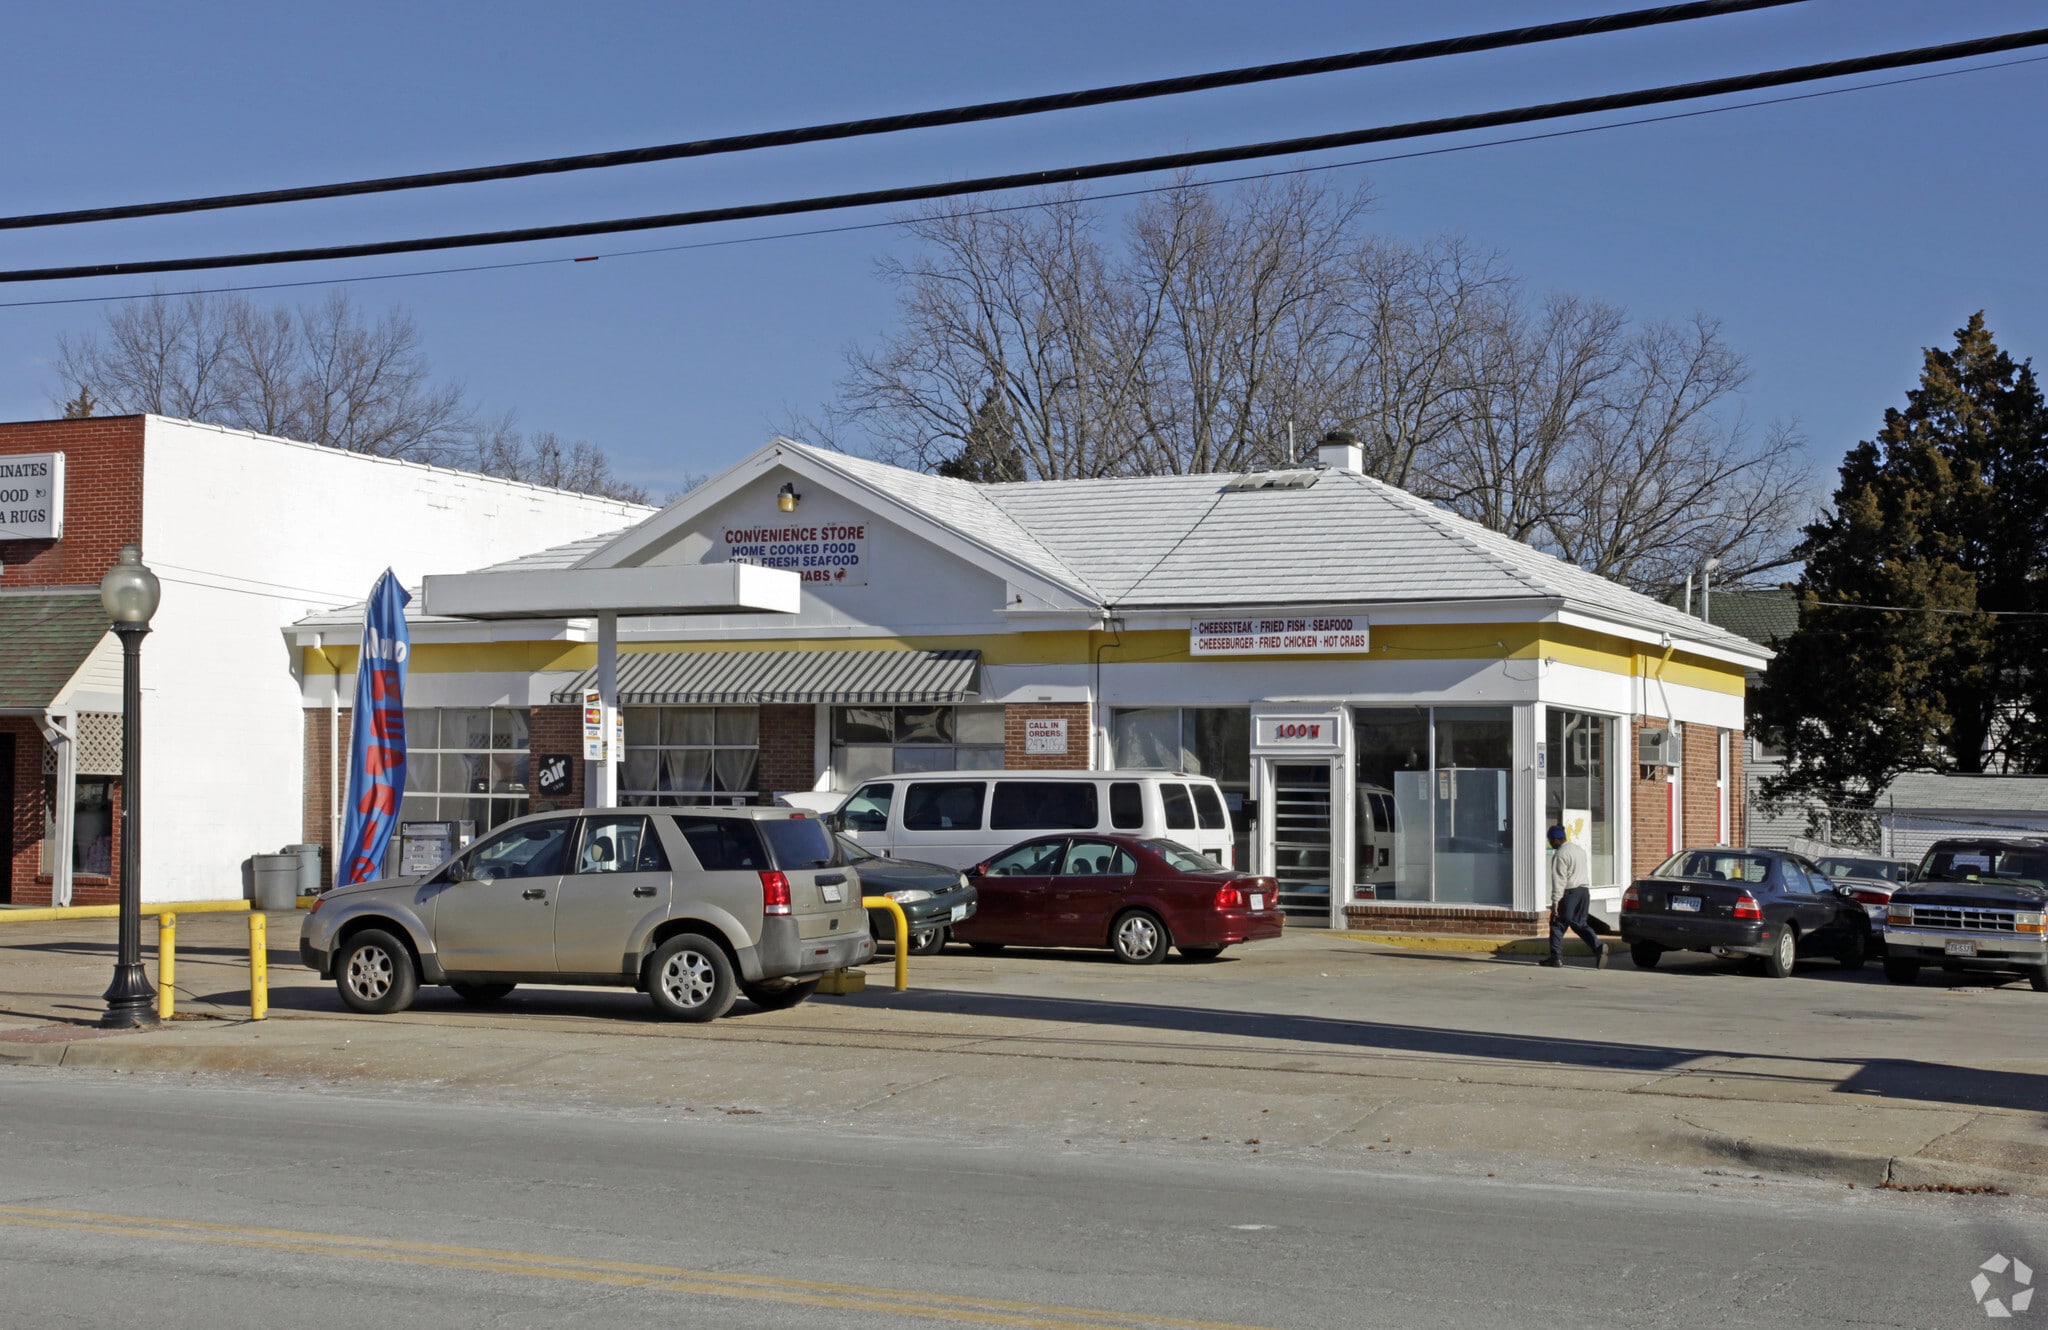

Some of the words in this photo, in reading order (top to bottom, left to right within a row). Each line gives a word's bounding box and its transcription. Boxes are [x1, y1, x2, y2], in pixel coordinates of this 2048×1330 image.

[10, 509, 46, 524] RUGS
[725, 527, 818, 544] CONVENIENCE
[821, 526, 865, 541] STORE
[732, 545, 766, 557] HOME
[769, 544, 819, 556] COOKED
[823, 542, 856, 554] FOOD
[761, 556, 799, 568] FRESH
[802, 554, 859, 567] SEAFOOD
[799, 569, 830, 582] RABS
[1199, 621, 1253, 634] CHEESESTEAK
[1260, 620, 1284, 632] FRIED
[1286, 620, 1306, 632] FISH
[1312, 618, 1353, 631] SEAFOOD
[1199, 637, 1254, 650] CHEESEBURGER
[1259, 636, 1281, 648] FRIED
[1283, 635, 1317, 648] CHICKEN
[1323, 635, 1338, 647] HOT
[1339, 635, 1365, 647] CRABS
[1028, 730, 1063, 738] ORDERS:
[539, 758, 566, 787] air
